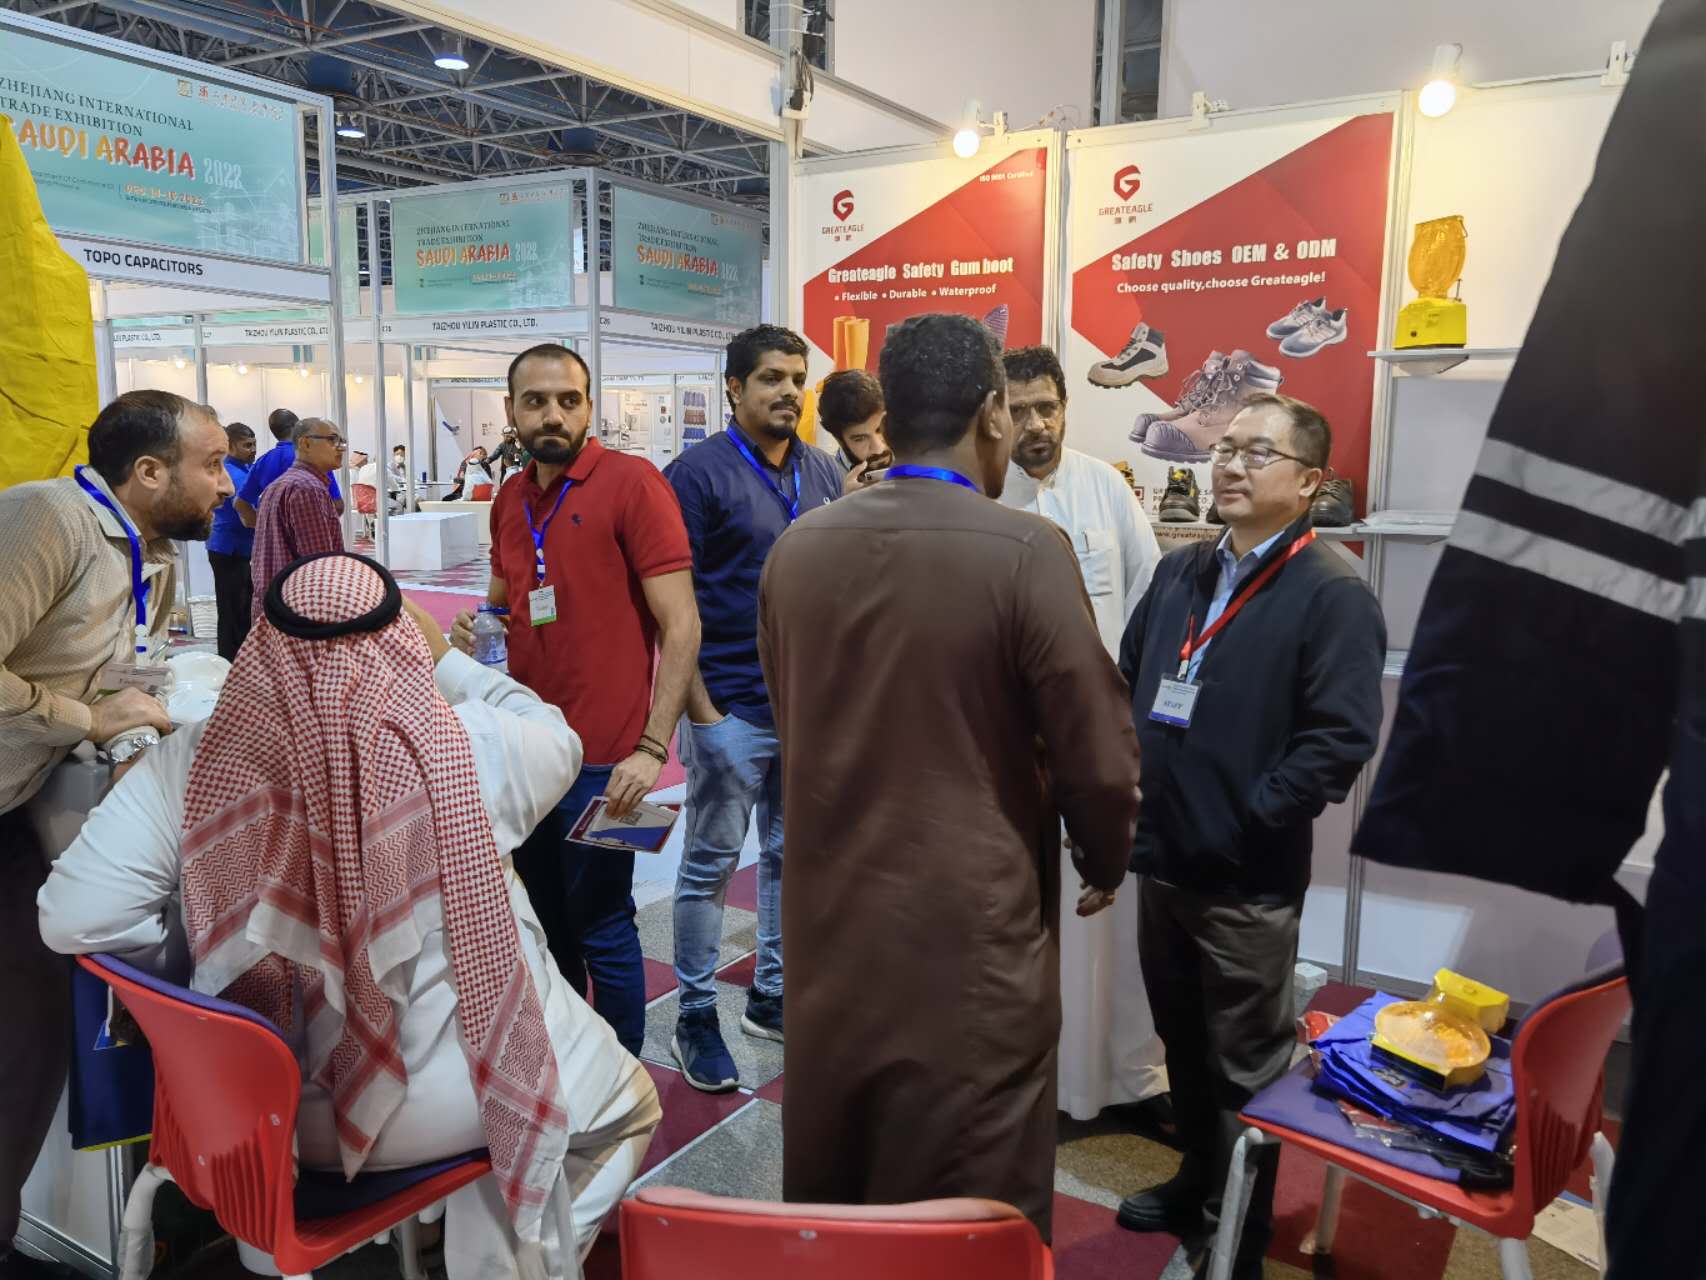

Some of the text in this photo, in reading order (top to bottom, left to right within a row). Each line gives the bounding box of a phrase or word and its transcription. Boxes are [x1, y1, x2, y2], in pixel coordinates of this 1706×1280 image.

[0, 95, 143, 137] TRADE EXHIBITION
[79, 95, 194, 131] INTERNATIONAL
[9, 115, 88, 158] AUDI
[95, 135, 196, 180] ARABIA
[203, 157, 243, 189] 2022
[1099, 203, 1152, 216] GREATEAGLE
[822, 223, 864, 235] GREATEAGLE
[83, 248, 203, 276] TOPO CAPACITORS
[416, 241, 511, 269] SAUDI ARABIA
[637, 243, 719, 277] SAUDI ARABIA
[1111, 238, 1337, 271] Safety Shoes OEM & ODM
[828, 264, 897, 284] Greateagle
[902, 261, 945, 279] Safety
[1117, 281, 1159, 294] Choose
[1250, 270, 1327, 287] Greateagle!
[842, 283, 997, 302] Flexible Durable Waterproof
